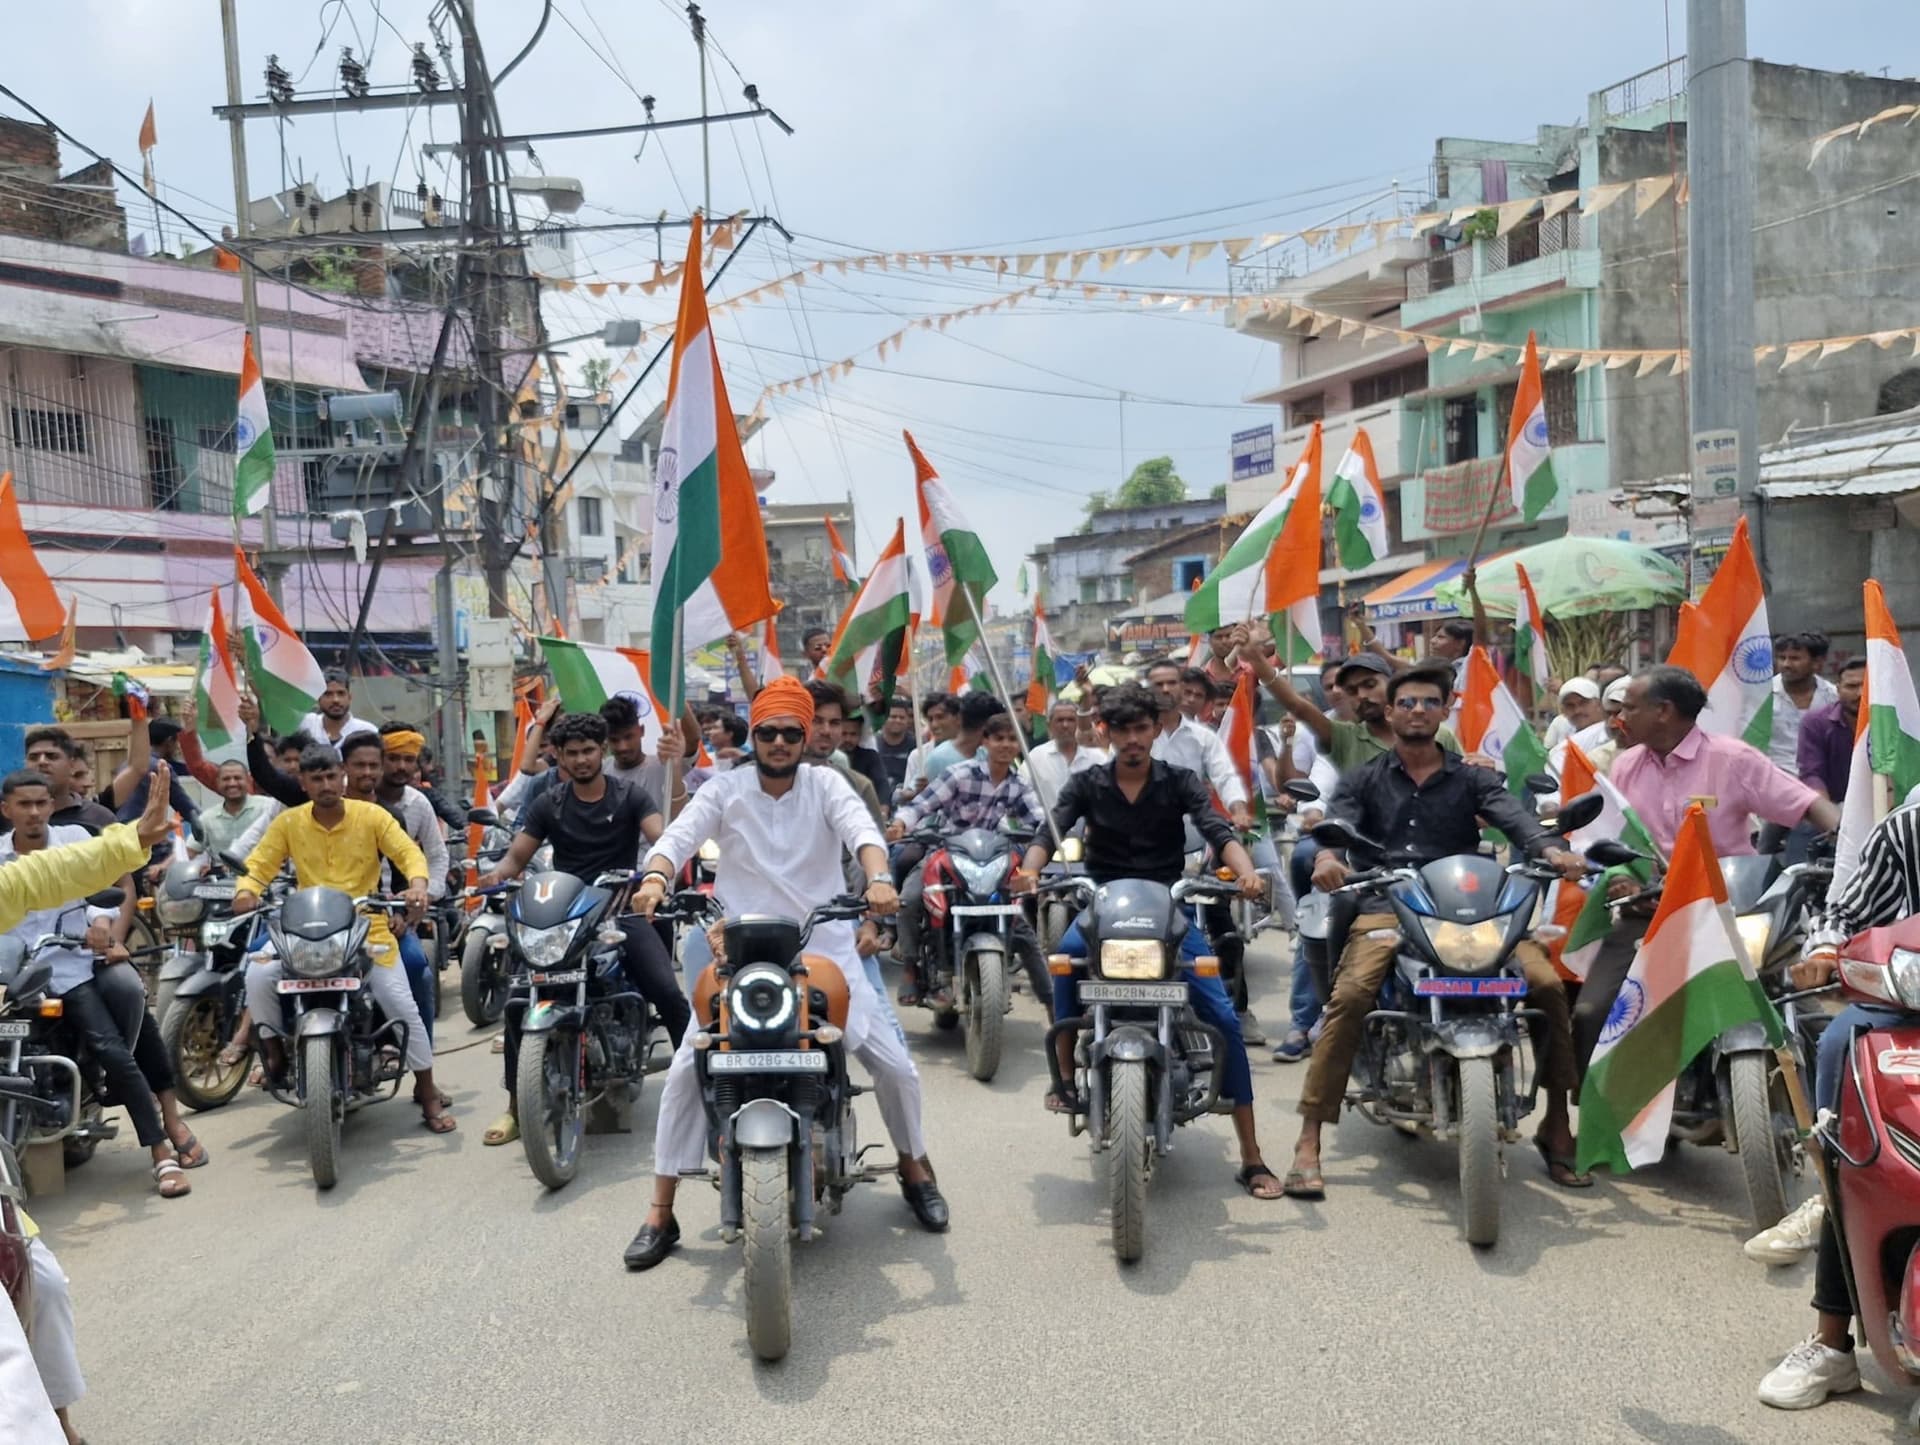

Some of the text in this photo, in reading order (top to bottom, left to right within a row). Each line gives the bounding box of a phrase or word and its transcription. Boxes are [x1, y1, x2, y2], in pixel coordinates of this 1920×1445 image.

[282, 978, 358, 990] POLICE
[1418, 980, 1522, 994] INDIAN ARMY
